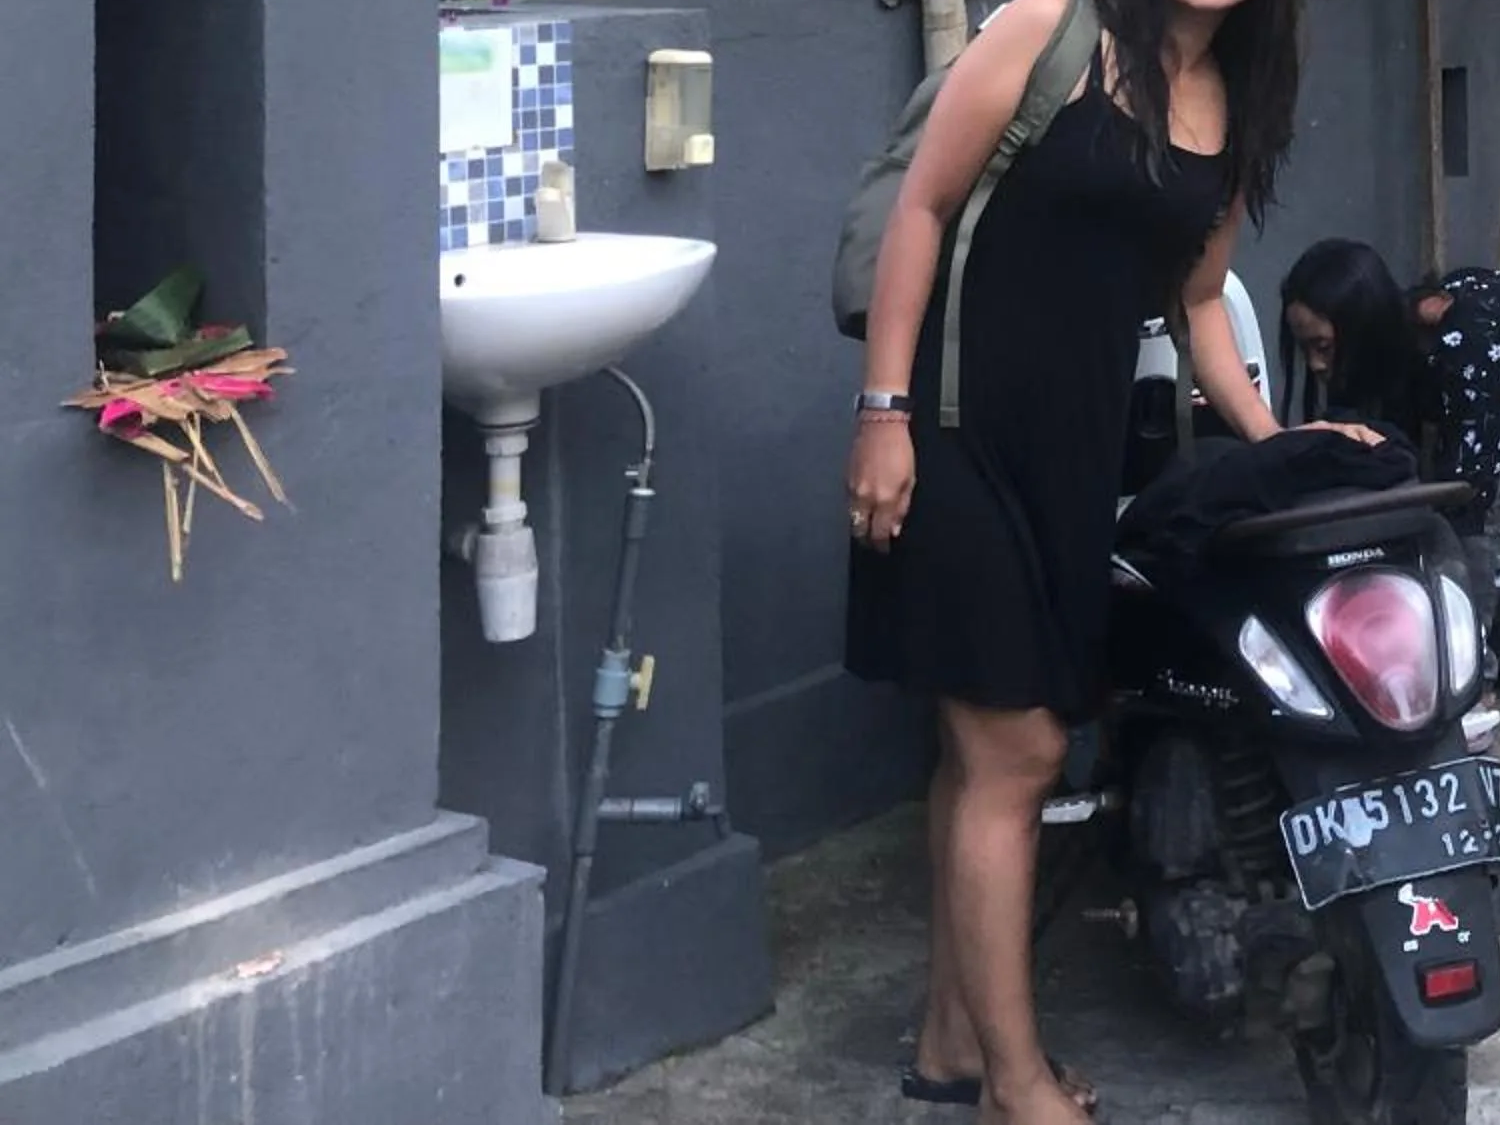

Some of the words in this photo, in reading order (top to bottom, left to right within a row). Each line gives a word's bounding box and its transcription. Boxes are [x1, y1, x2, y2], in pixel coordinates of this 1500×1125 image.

[1327, 547, 1385, 567] HONDA
[1291, 799, 1346, 856] DK
[1361, 773, 1467, 831] 5132
